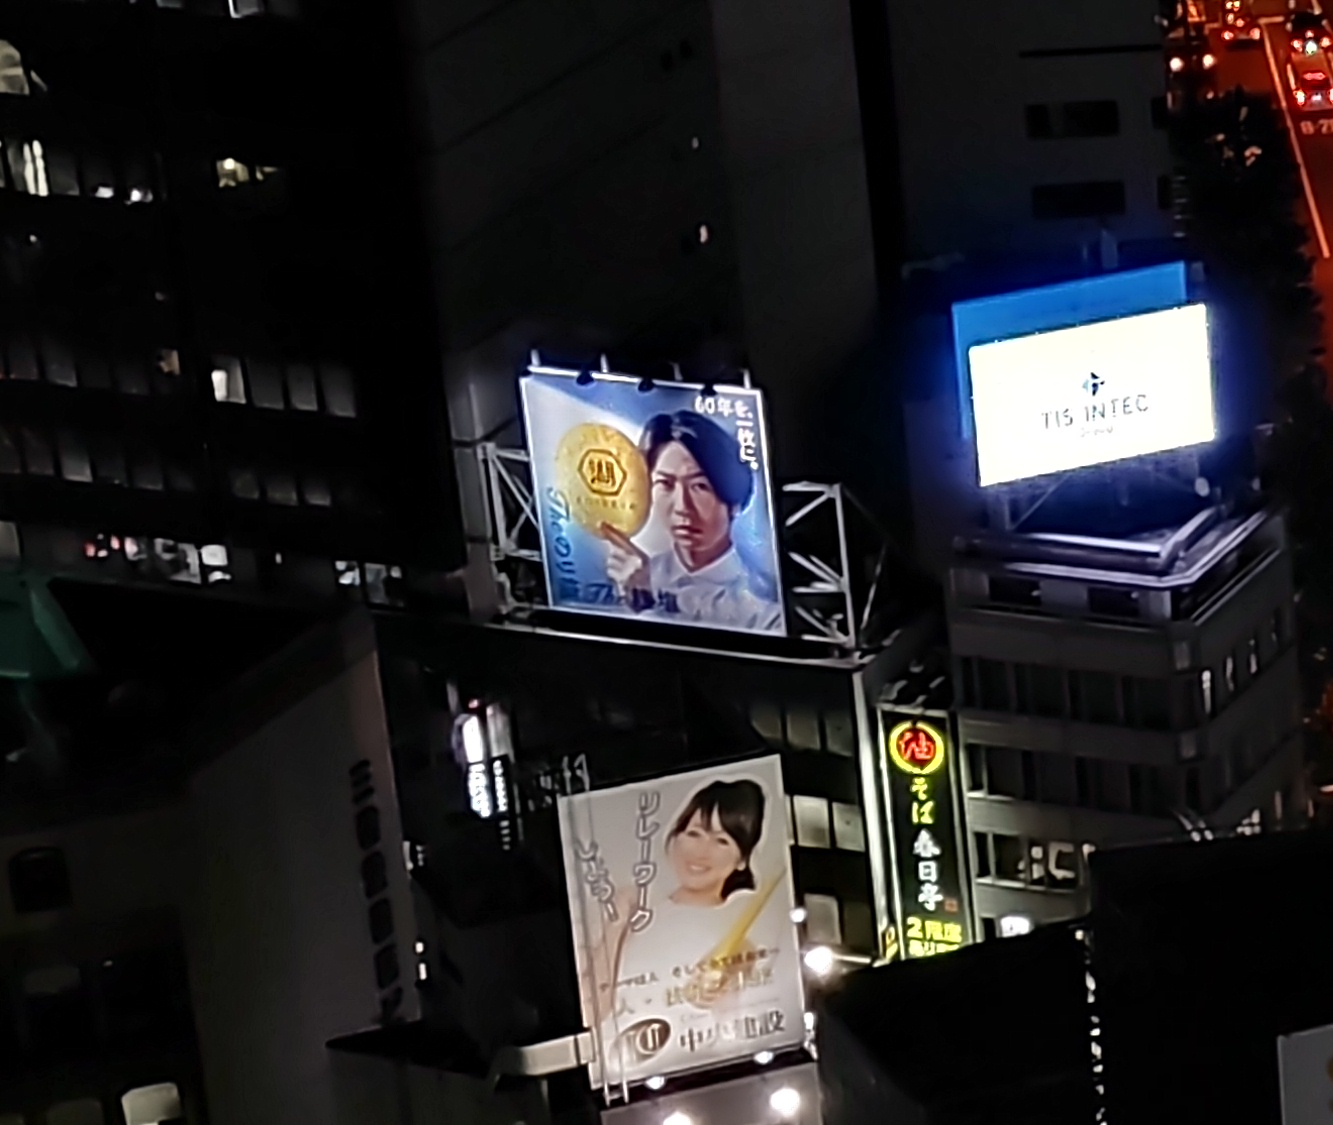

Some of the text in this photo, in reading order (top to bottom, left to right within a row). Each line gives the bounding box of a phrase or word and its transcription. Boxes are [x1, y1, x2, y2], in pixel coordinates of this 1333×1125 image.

[1040, 394, 1149, 429] TIS INTEC
[911, 777, 935, 824] そば
[629, 790, 661, 932] リレーワーク
[913, 828, 944, 911] 春日亭
